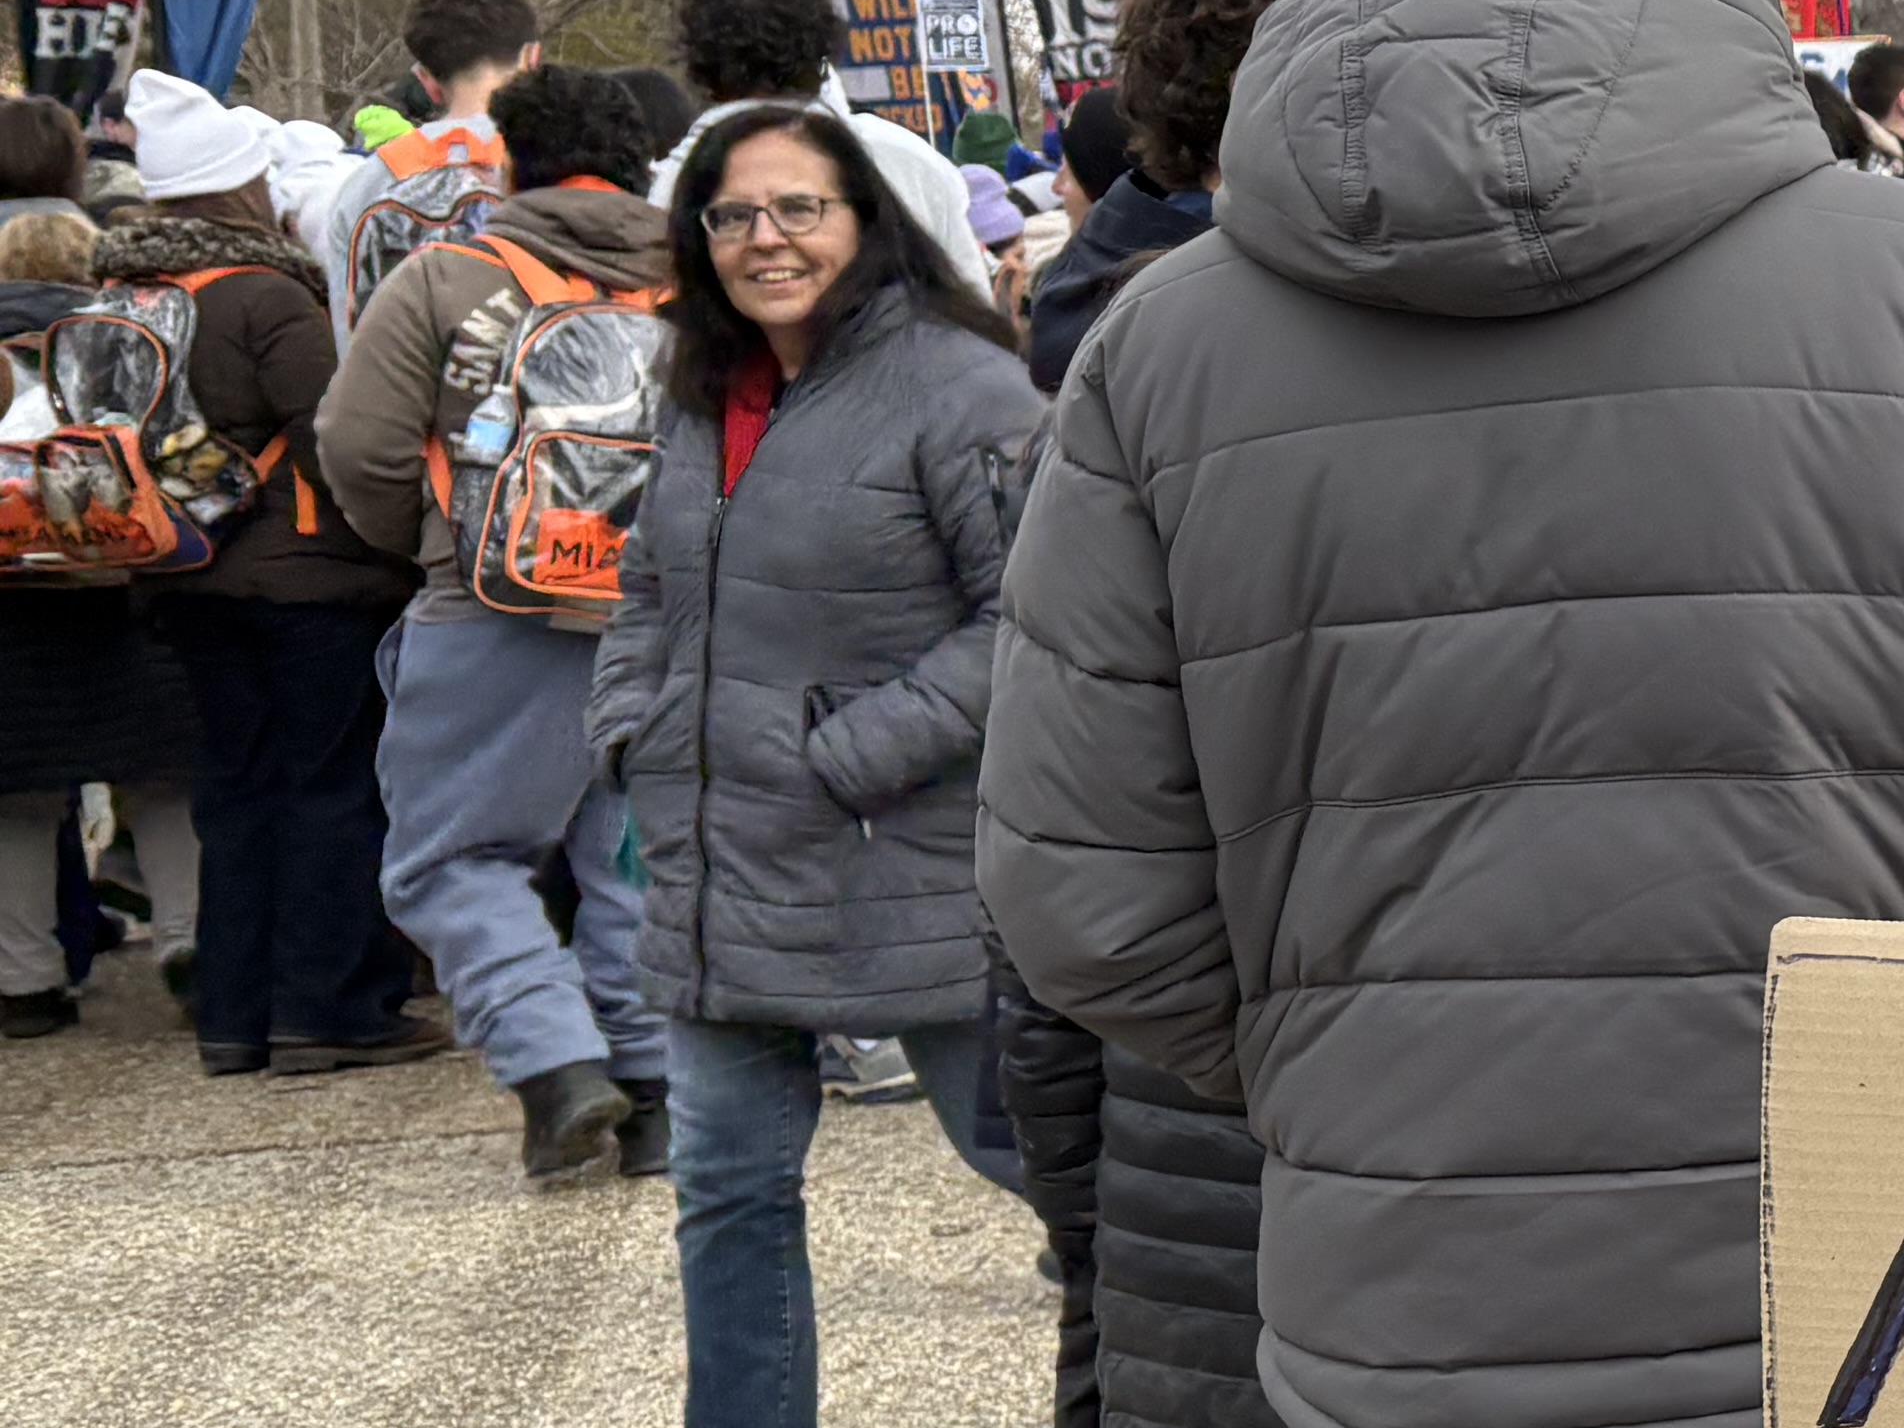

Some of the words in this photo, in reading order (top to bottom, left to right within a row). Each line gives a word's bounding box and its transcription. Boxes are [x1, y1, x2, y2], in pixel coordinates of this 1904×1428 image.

[849, 25, 914, 64] NOT
[928, 35, 982, 60] LIFE
[1049, 42, 1114, 80] NO
